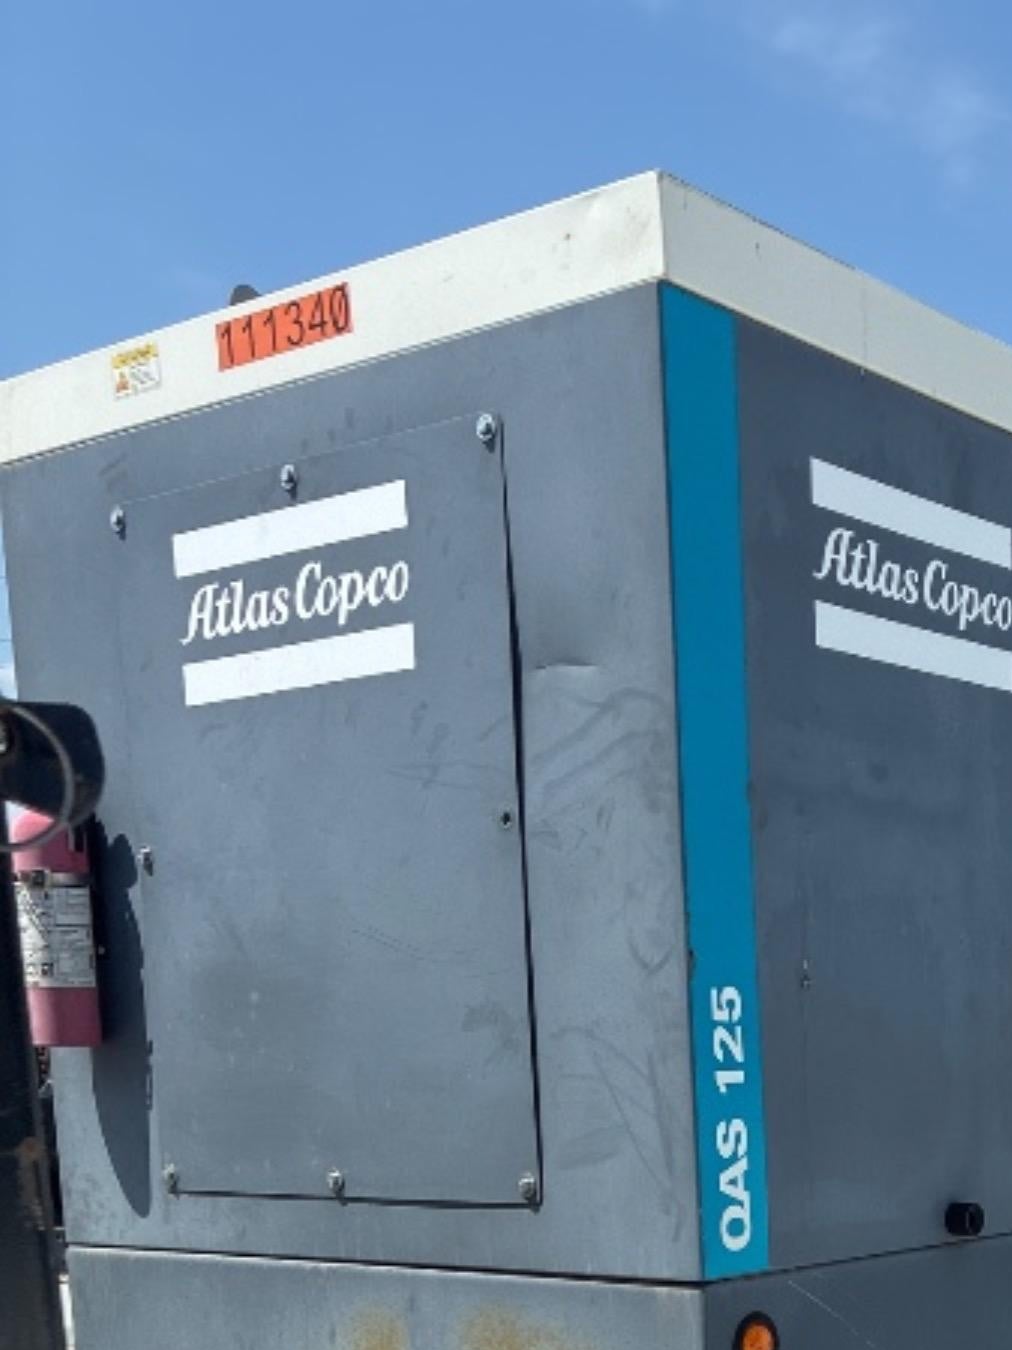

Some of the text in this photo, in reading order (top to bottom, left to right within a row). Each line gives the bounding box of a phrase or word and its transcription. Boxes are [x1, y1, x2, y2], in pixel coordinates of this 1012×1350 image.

[220, 284, 352, 365] 111340
[179, 560, 410, 646] Atlas Copco
[812, 527, 919, 604] Atlas
[710, 985, 752, 1252] QAS 125
